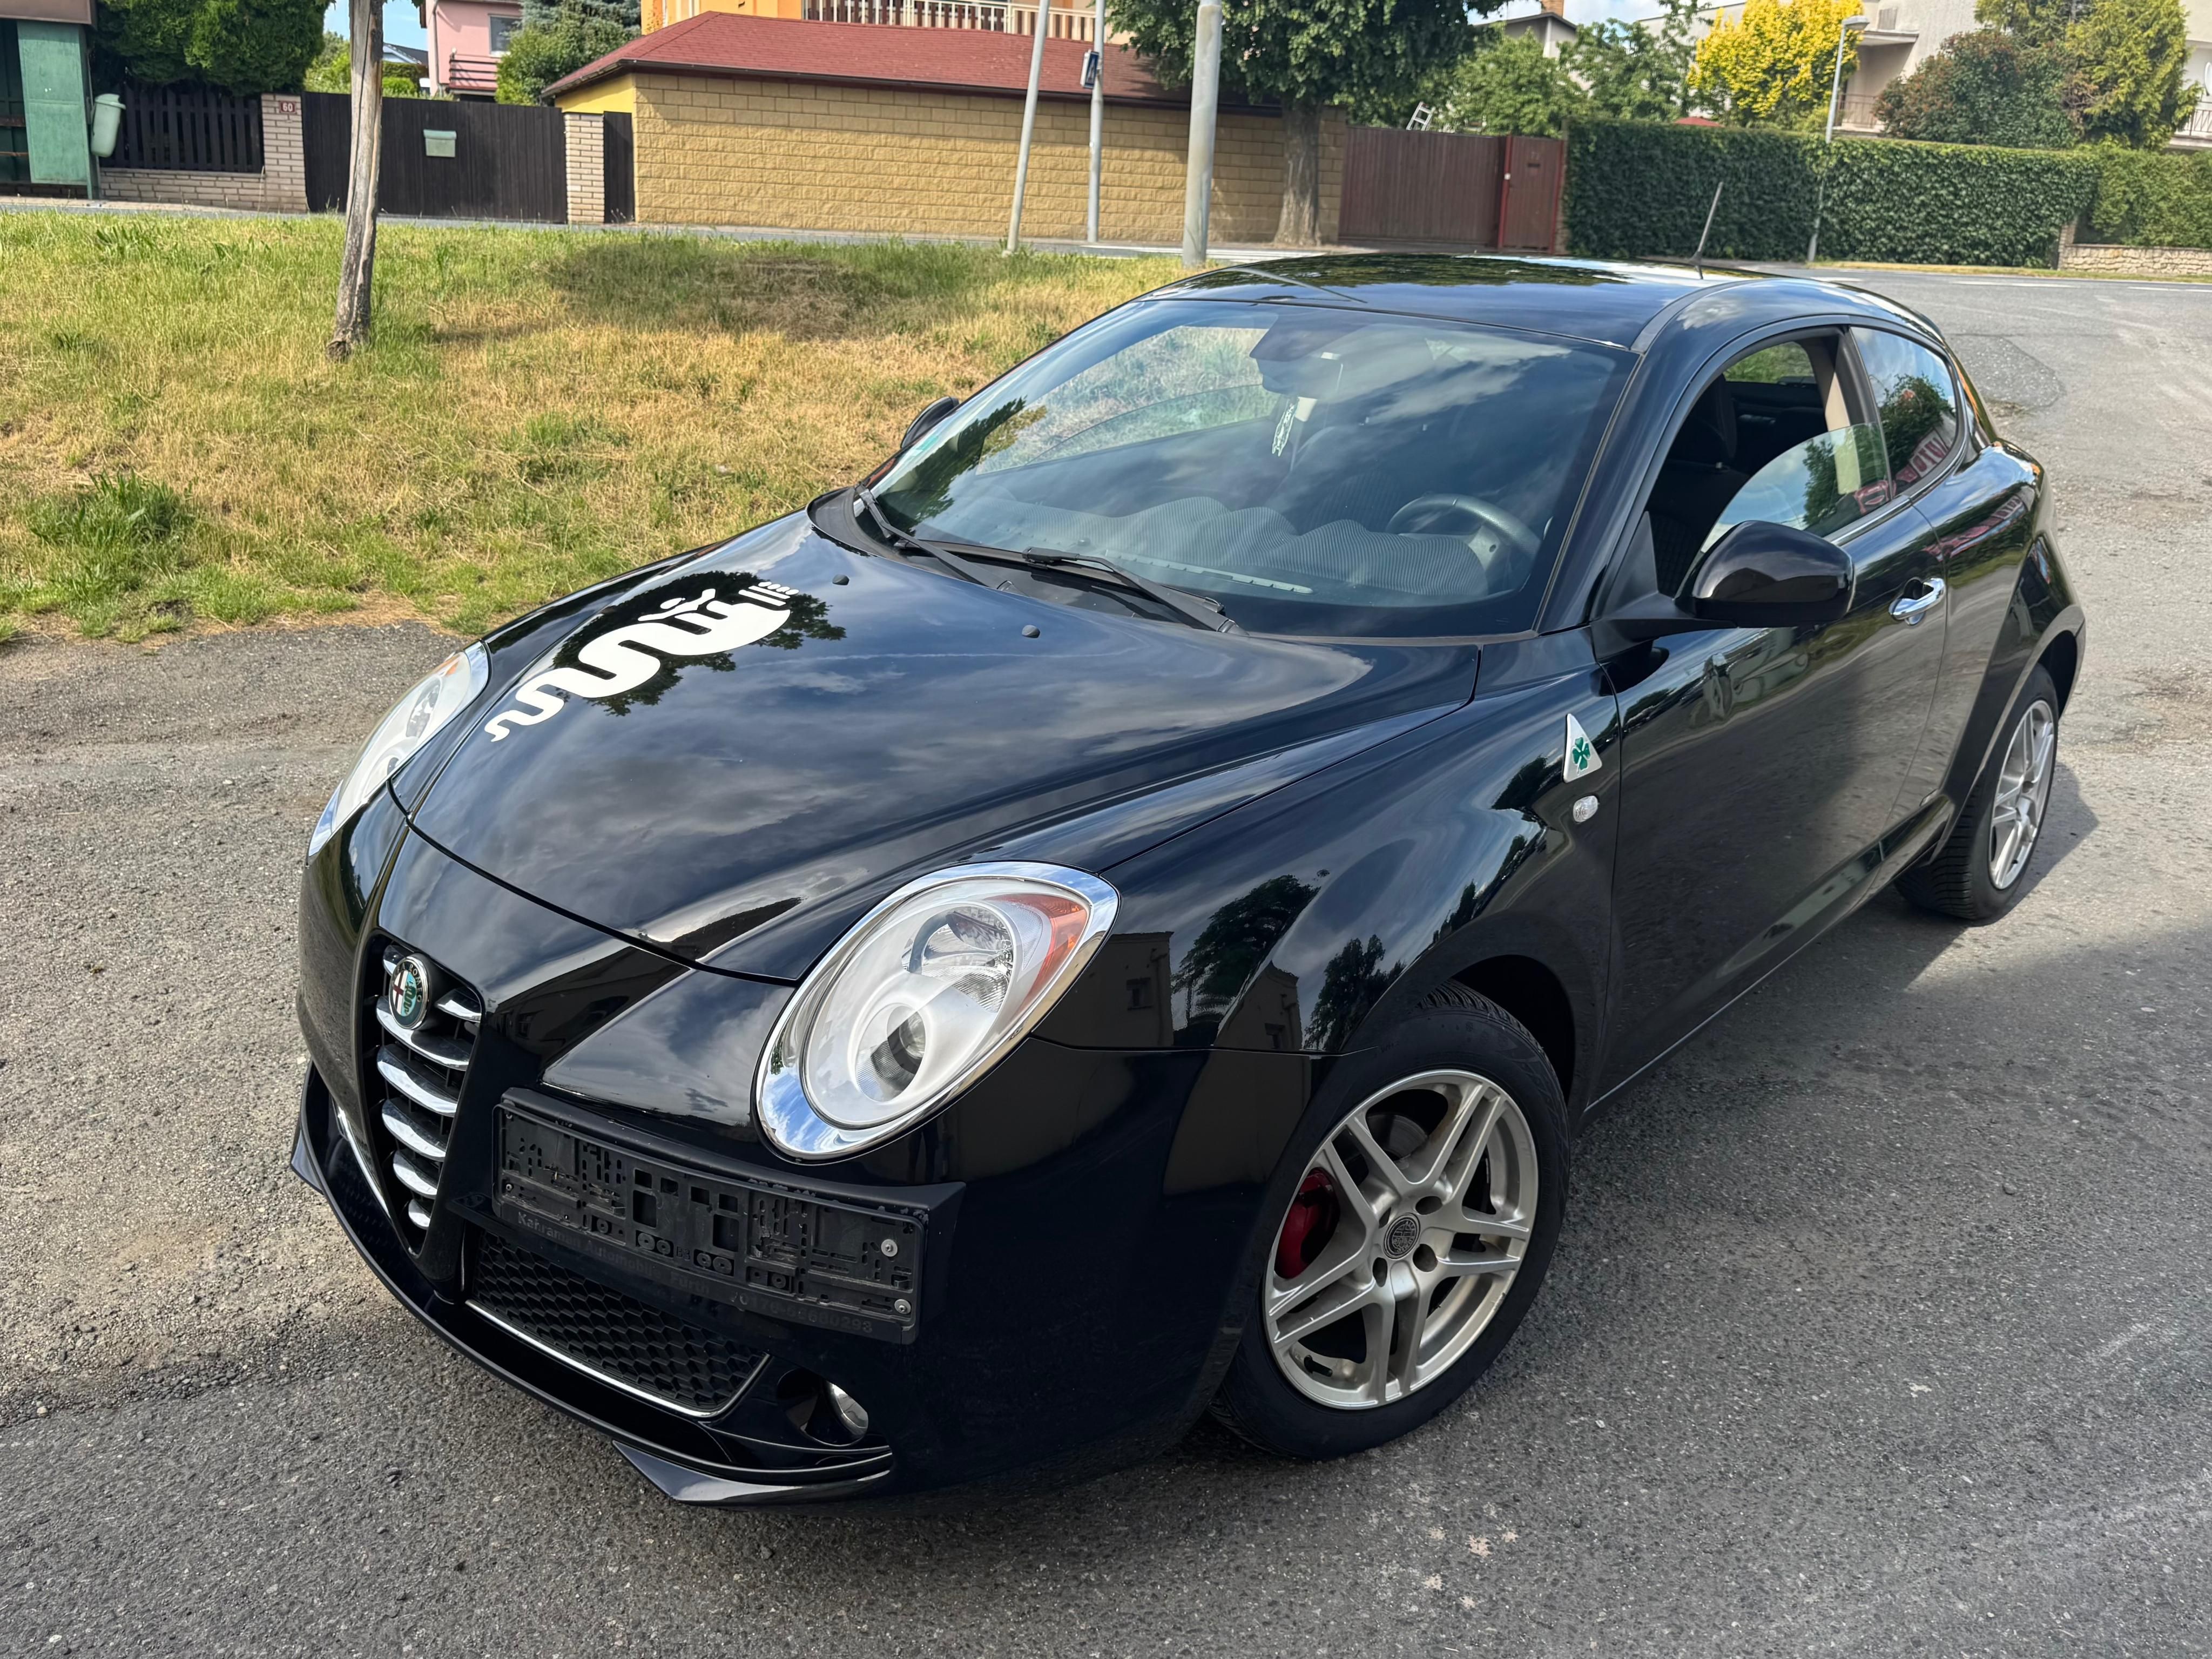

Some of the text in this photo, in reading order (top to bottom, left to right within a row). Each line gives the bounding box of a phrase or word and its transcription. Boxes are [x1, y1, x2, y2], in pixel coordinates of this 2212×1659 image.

[282, 102, 293, 112] 60
[409, 963, 422, 1003] ROMEO
[518, 1211, 582, 1249] Kahraman
